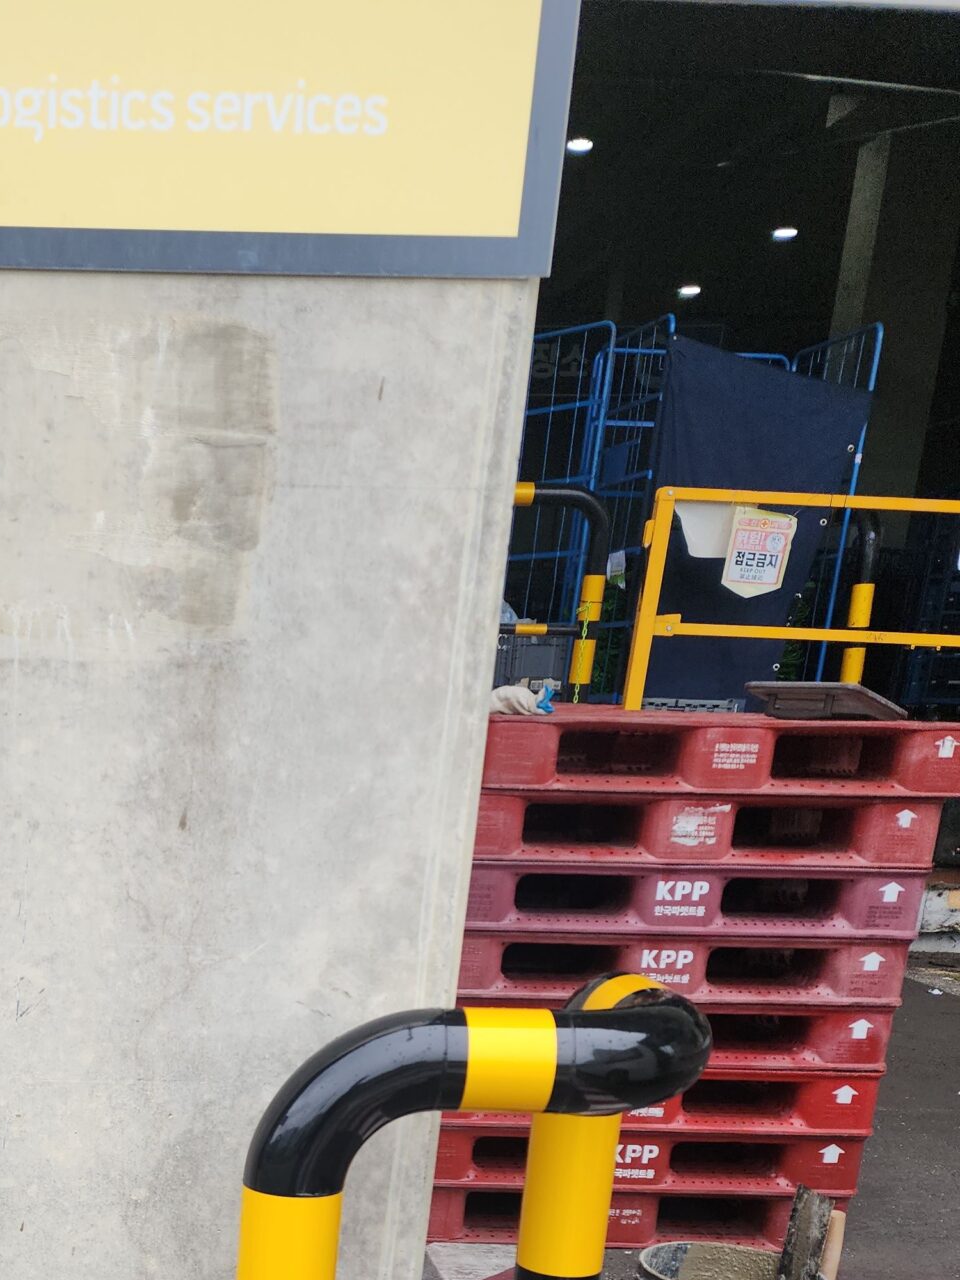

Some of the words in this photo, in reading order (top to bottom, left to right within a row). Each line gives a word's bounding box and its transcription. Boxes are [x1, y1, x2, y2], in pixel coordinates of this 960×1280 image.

[185, 79, 390, 136] services
[735, 551, 779, 568] 접근금지
[655, 880, 710, 901] KPP
[640, 949, 694, 969] KPP
